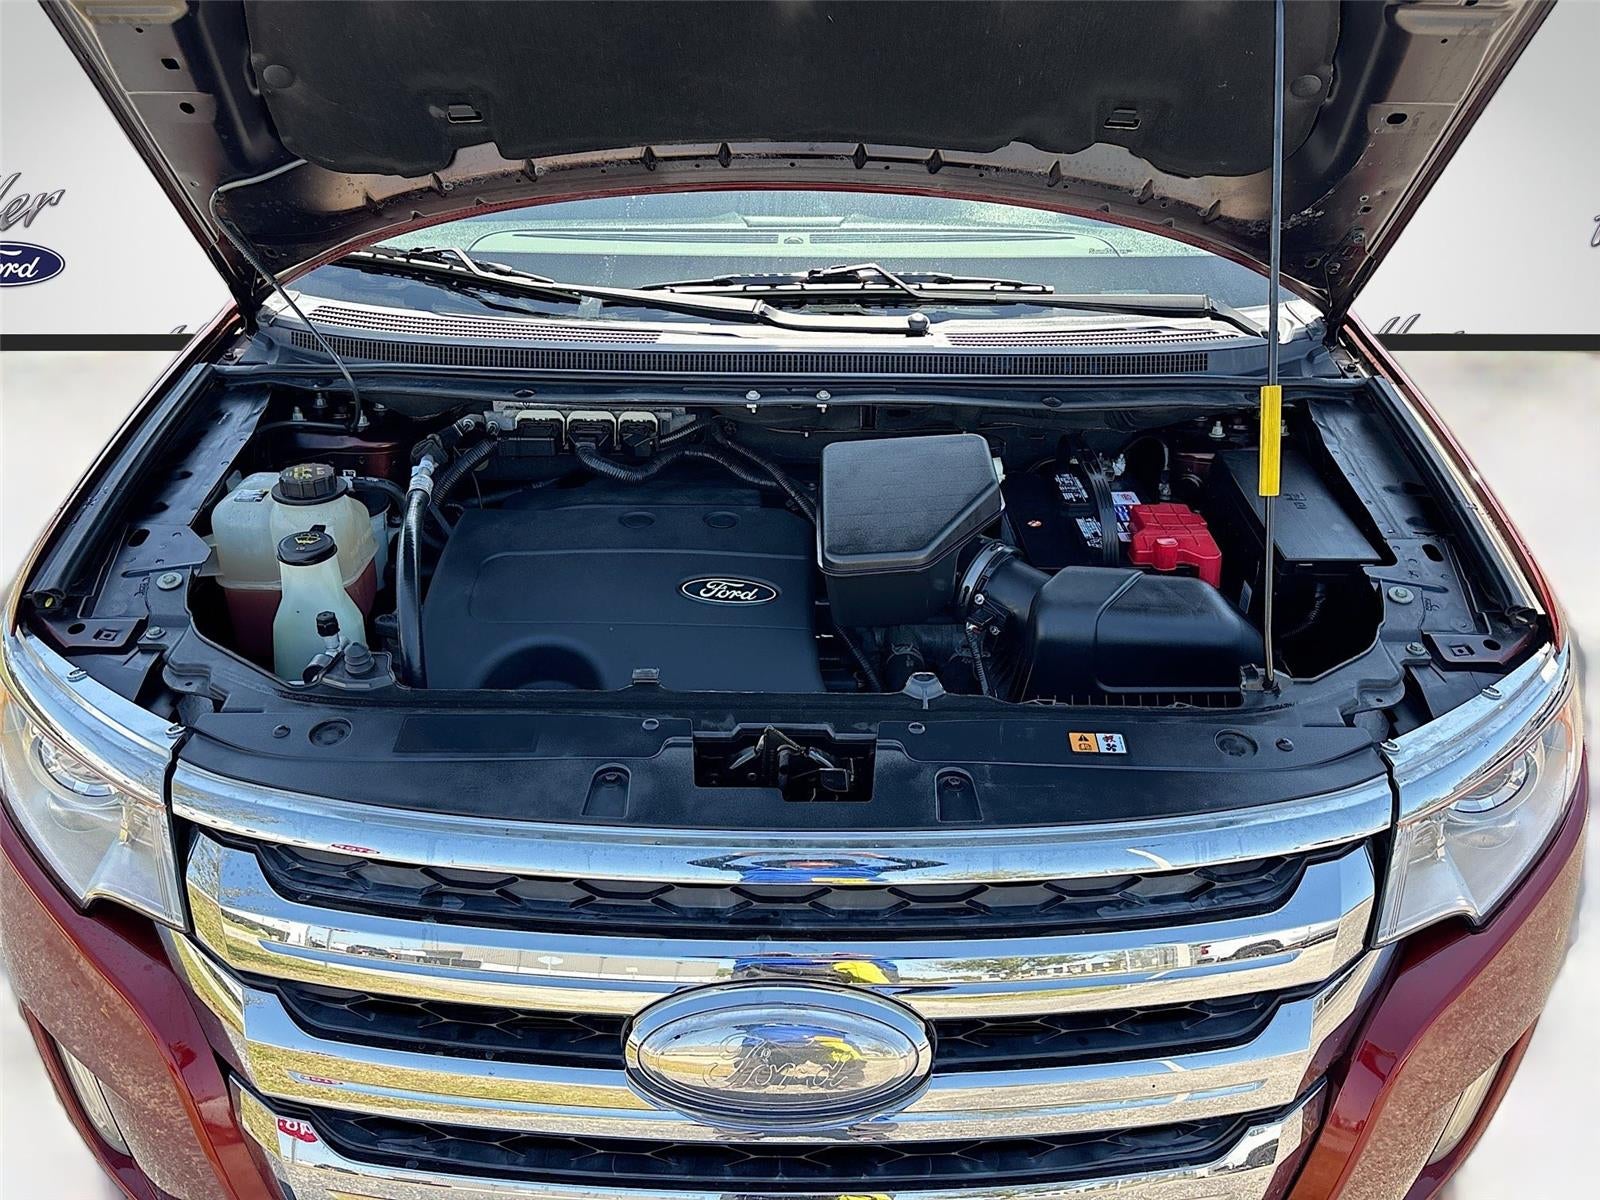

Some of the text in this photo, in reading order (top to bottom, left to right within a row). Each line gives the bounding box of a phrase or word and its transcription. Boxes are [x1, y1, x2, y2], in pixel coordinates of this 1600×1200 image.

[0, 249, 41, 278] rd
[699, 580, 759, 601] Ford
[702, 1032, 849, 1090] Ford
